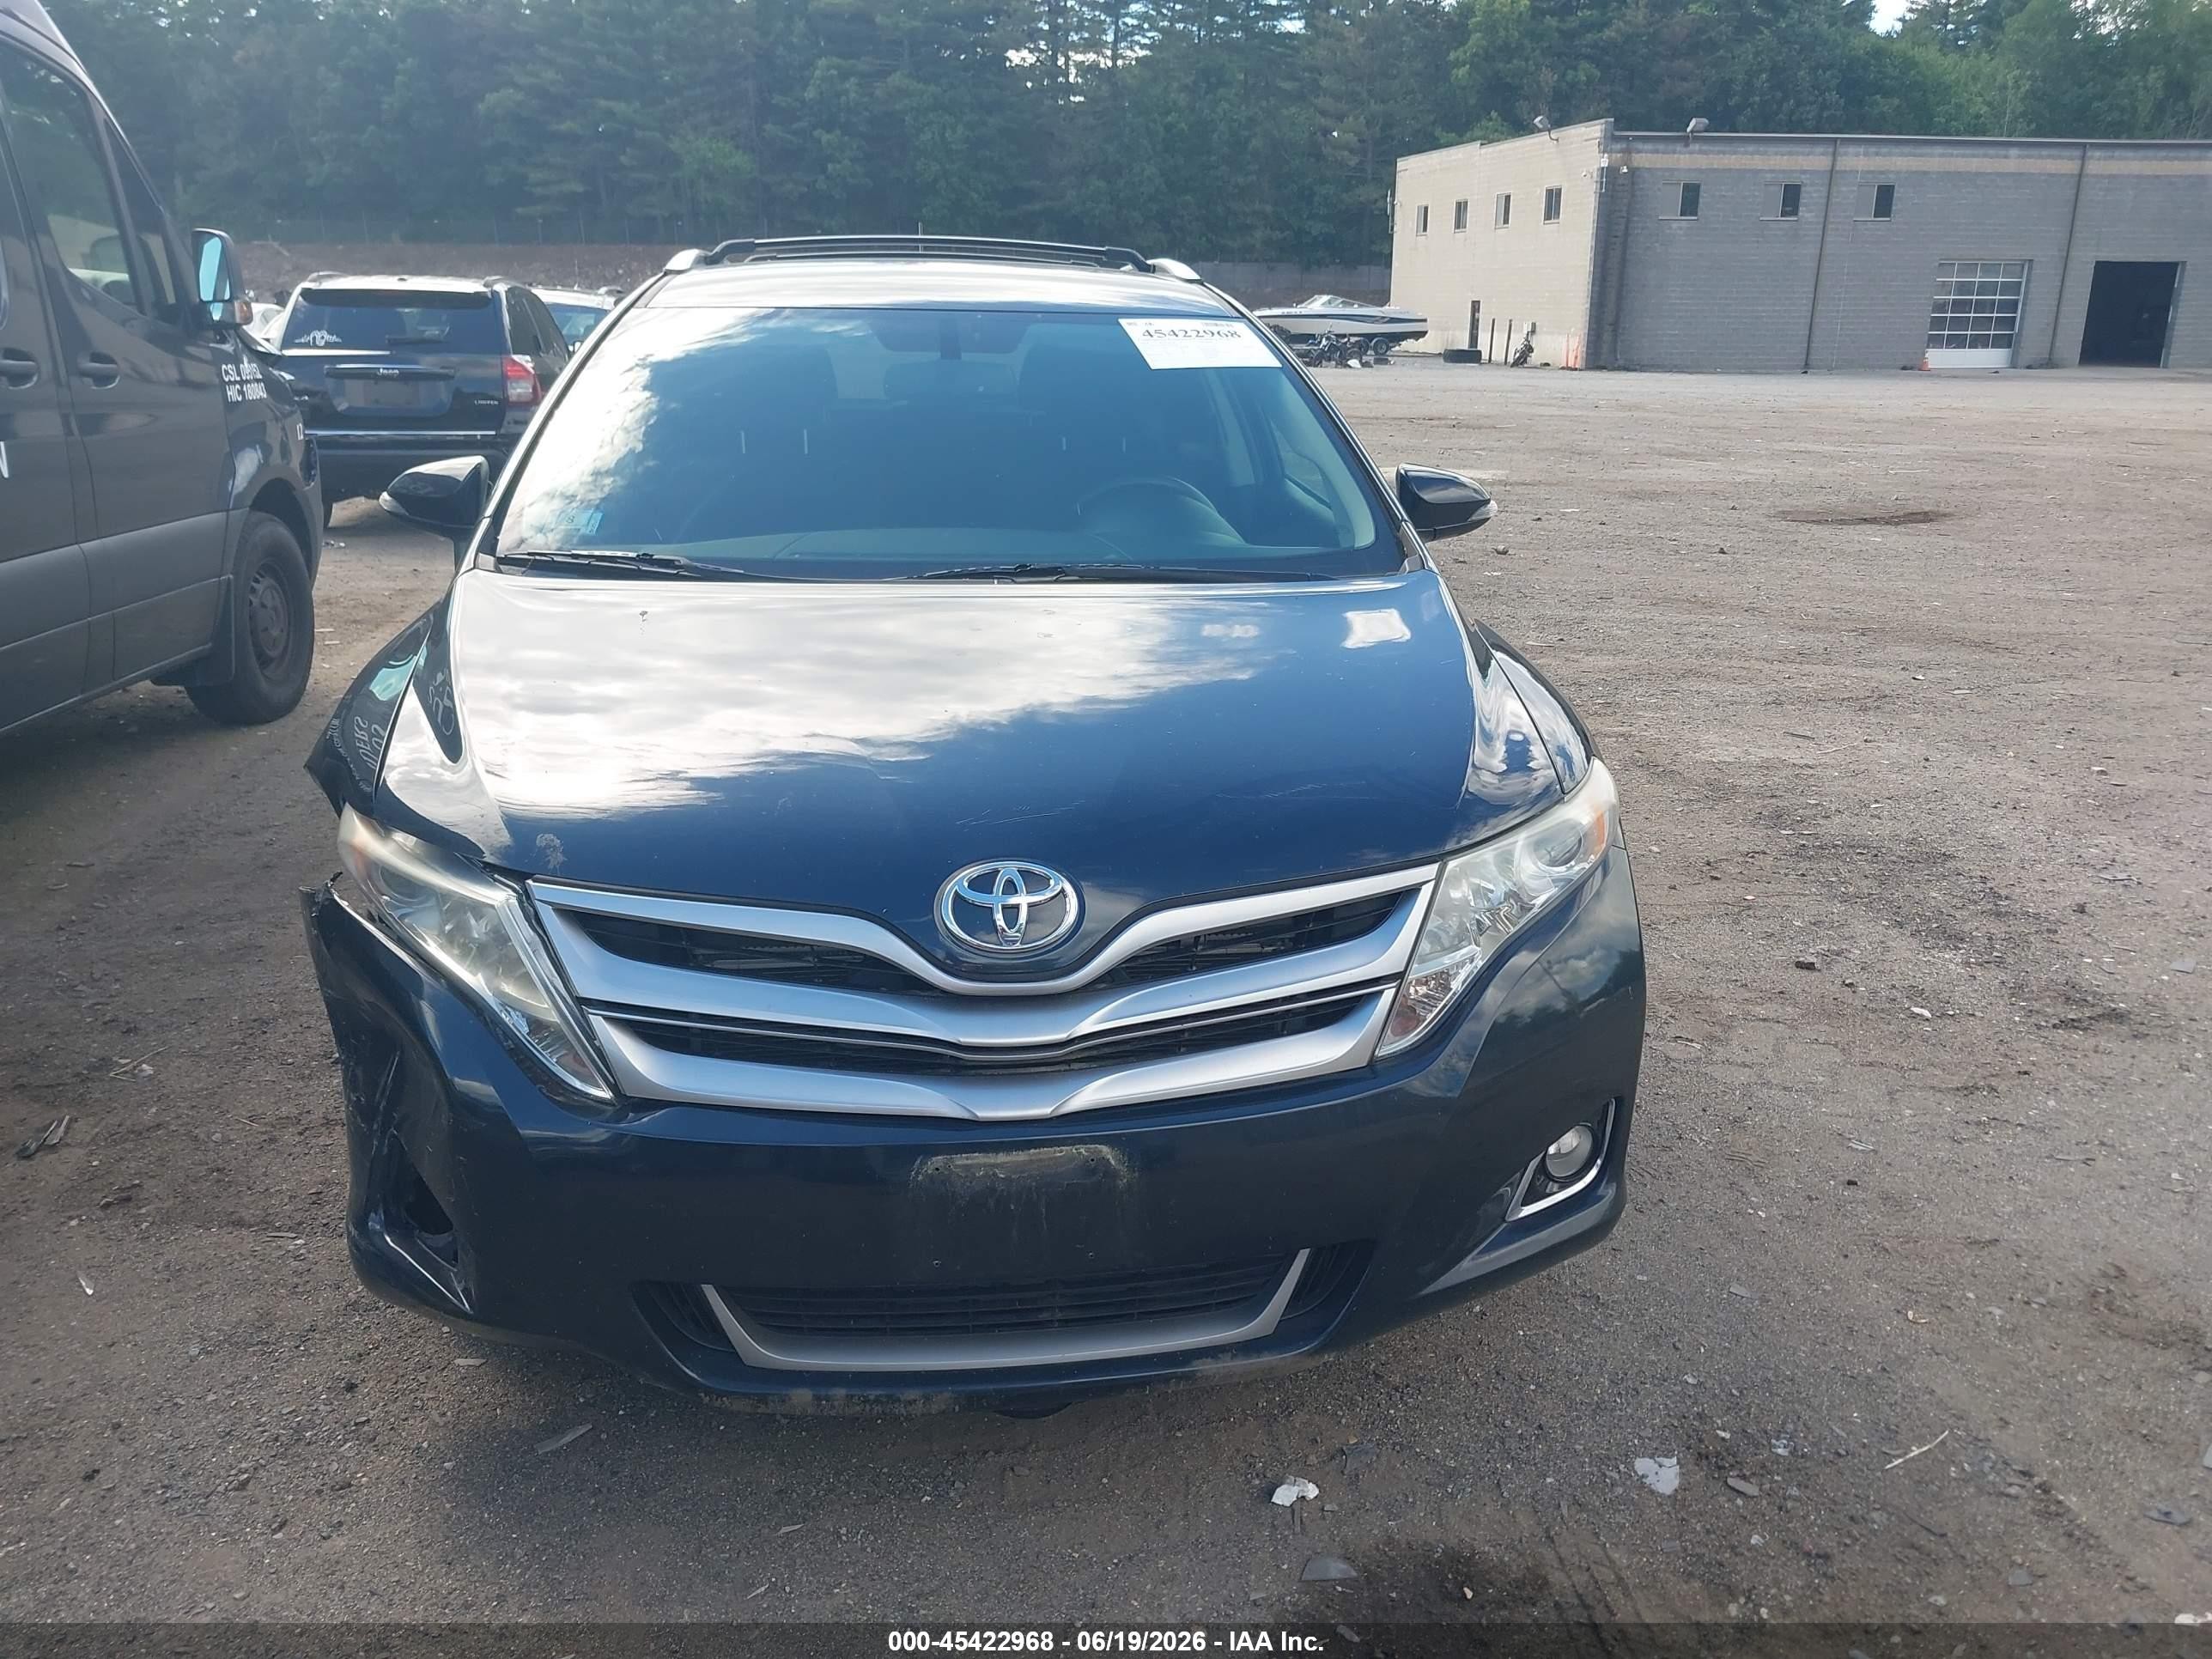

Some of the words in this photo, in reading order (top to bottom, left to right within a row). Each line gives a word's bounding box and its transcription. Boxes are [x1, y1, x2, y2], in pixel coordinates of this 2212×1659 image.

[1142, 329, 1242, 338] 45422968
[222, 363, 240, 382] CSL
[226, 384, 242, 403] HIC
